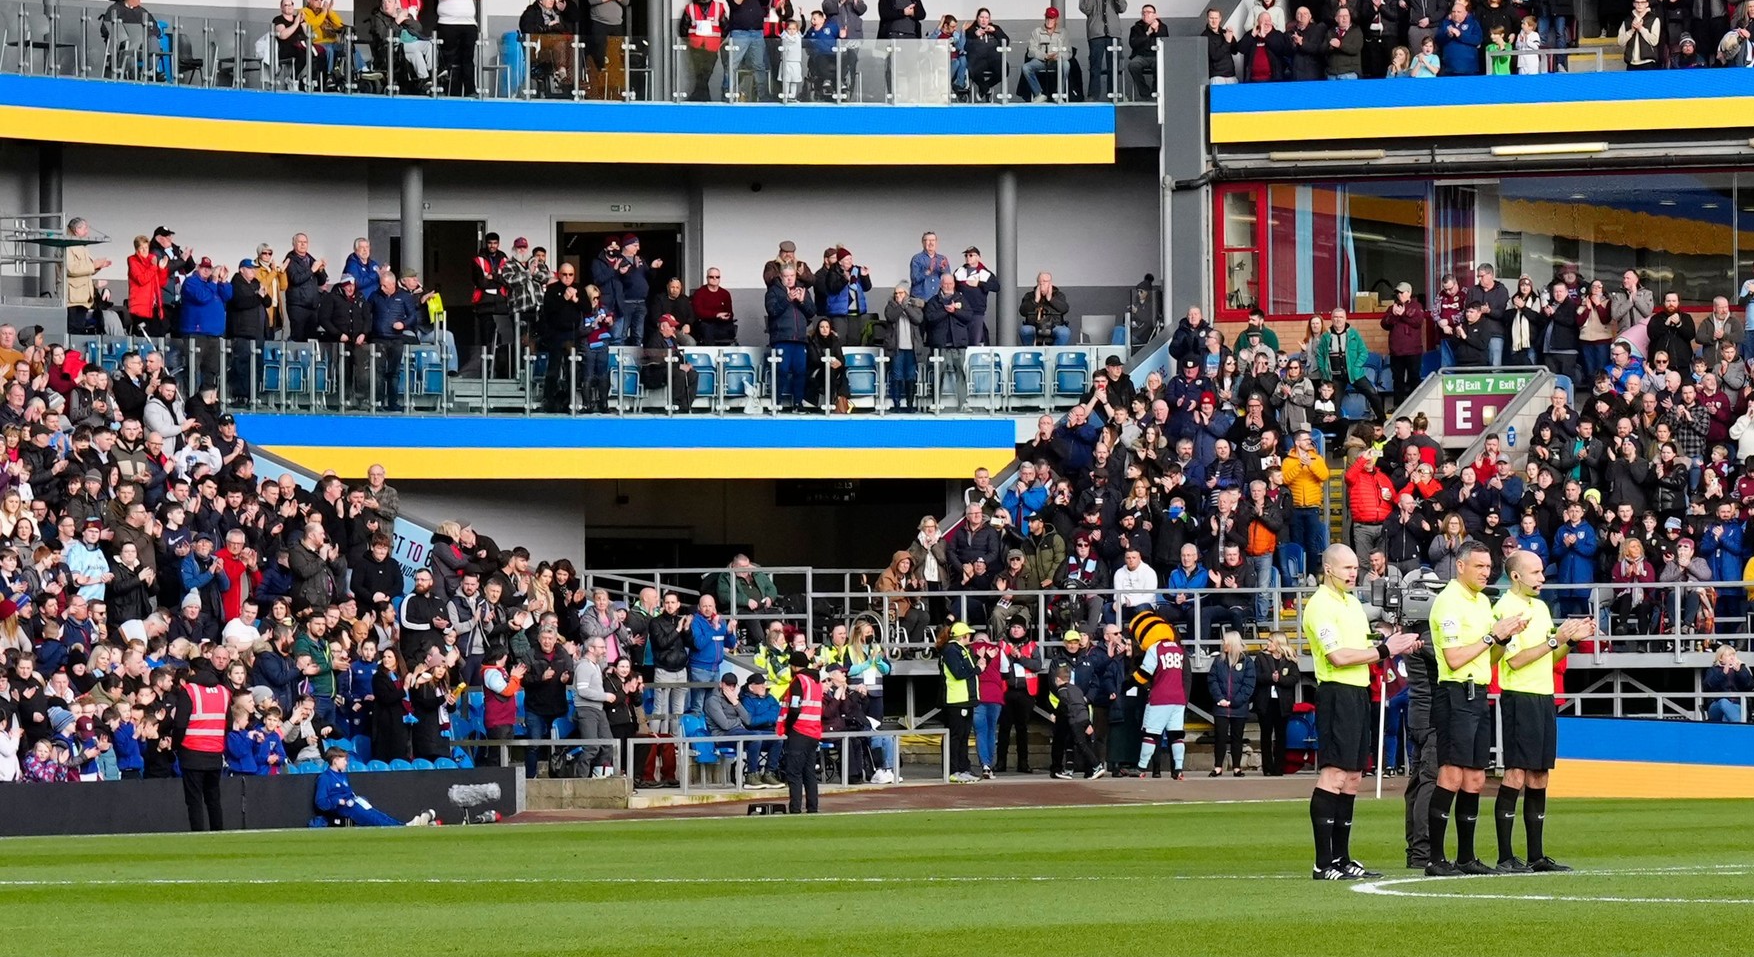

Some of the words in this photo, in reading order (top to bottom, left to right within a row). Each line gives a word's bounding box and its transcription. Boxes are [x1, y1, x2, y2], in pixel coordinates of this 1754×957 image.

[1465, 381, 1481, 391] Exit
[1486, 378, 1495, 392] 7
[1499, 380, 1515, 390] Exit
[1455, 400, 1472, 429] E
[406, 540, 423, 563] TO
